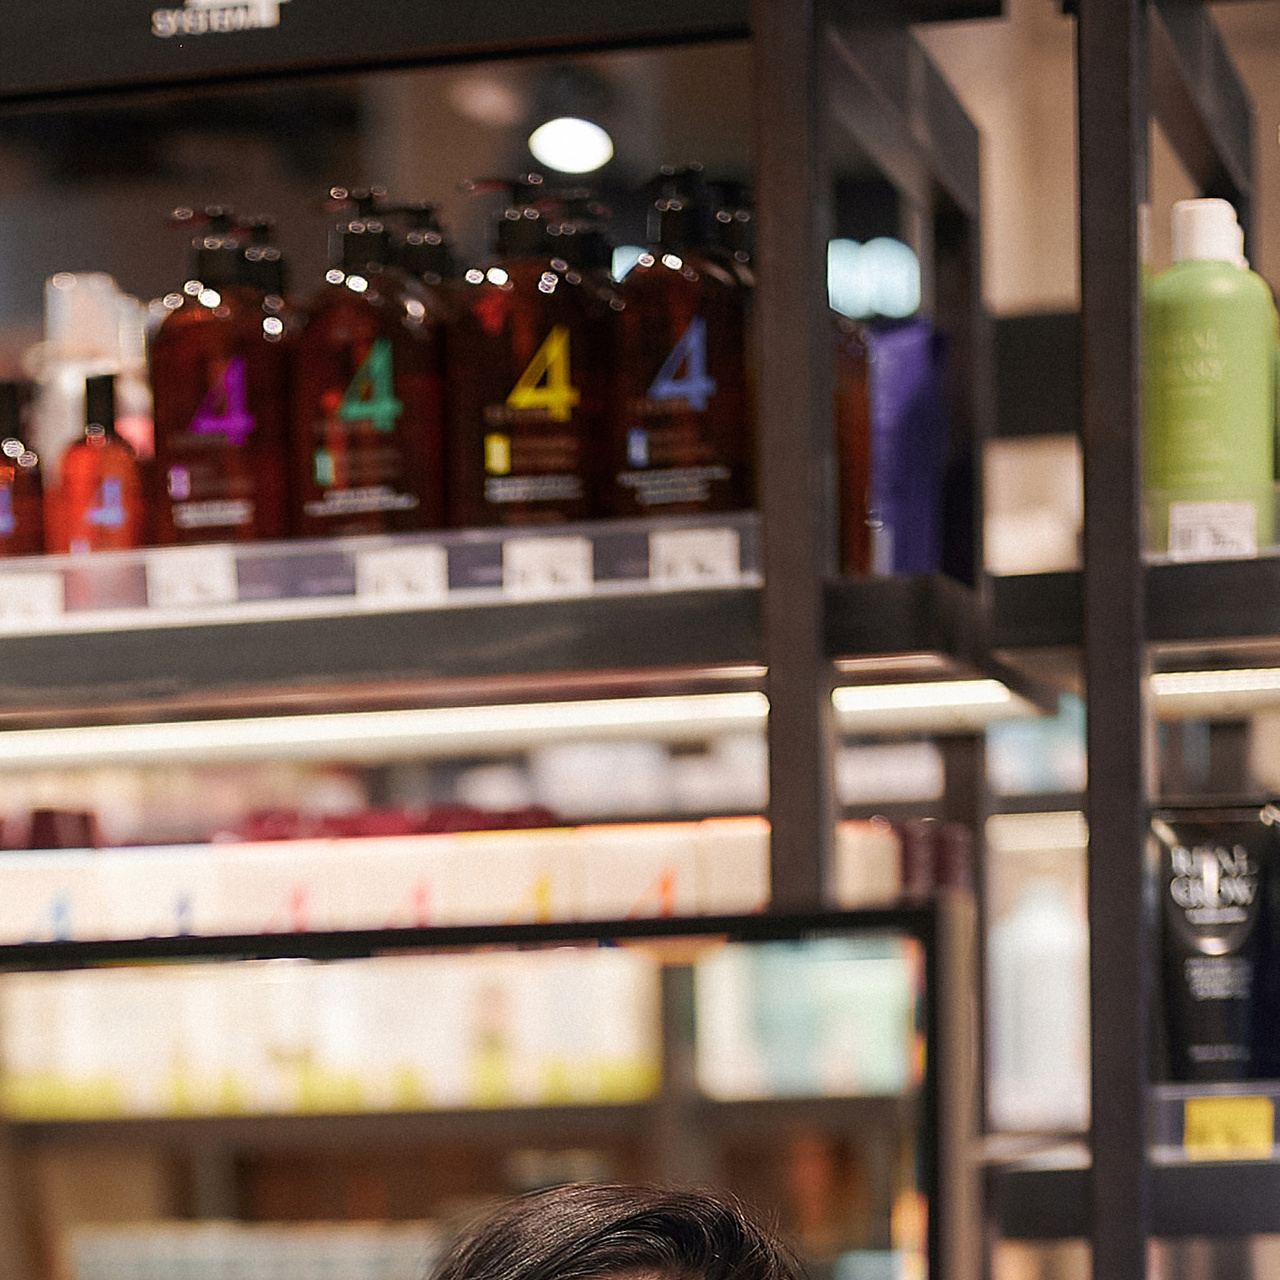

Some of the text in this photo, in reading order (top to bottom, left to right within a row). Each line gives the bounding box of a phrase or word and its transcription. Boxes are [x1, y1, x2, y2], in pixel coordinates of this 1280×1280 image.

[190, 357, 256, 445] 4
[338, 338, 404, 433] 4
[505, 324, 581, 422] 4
[646, 315, 716, 412] 4
